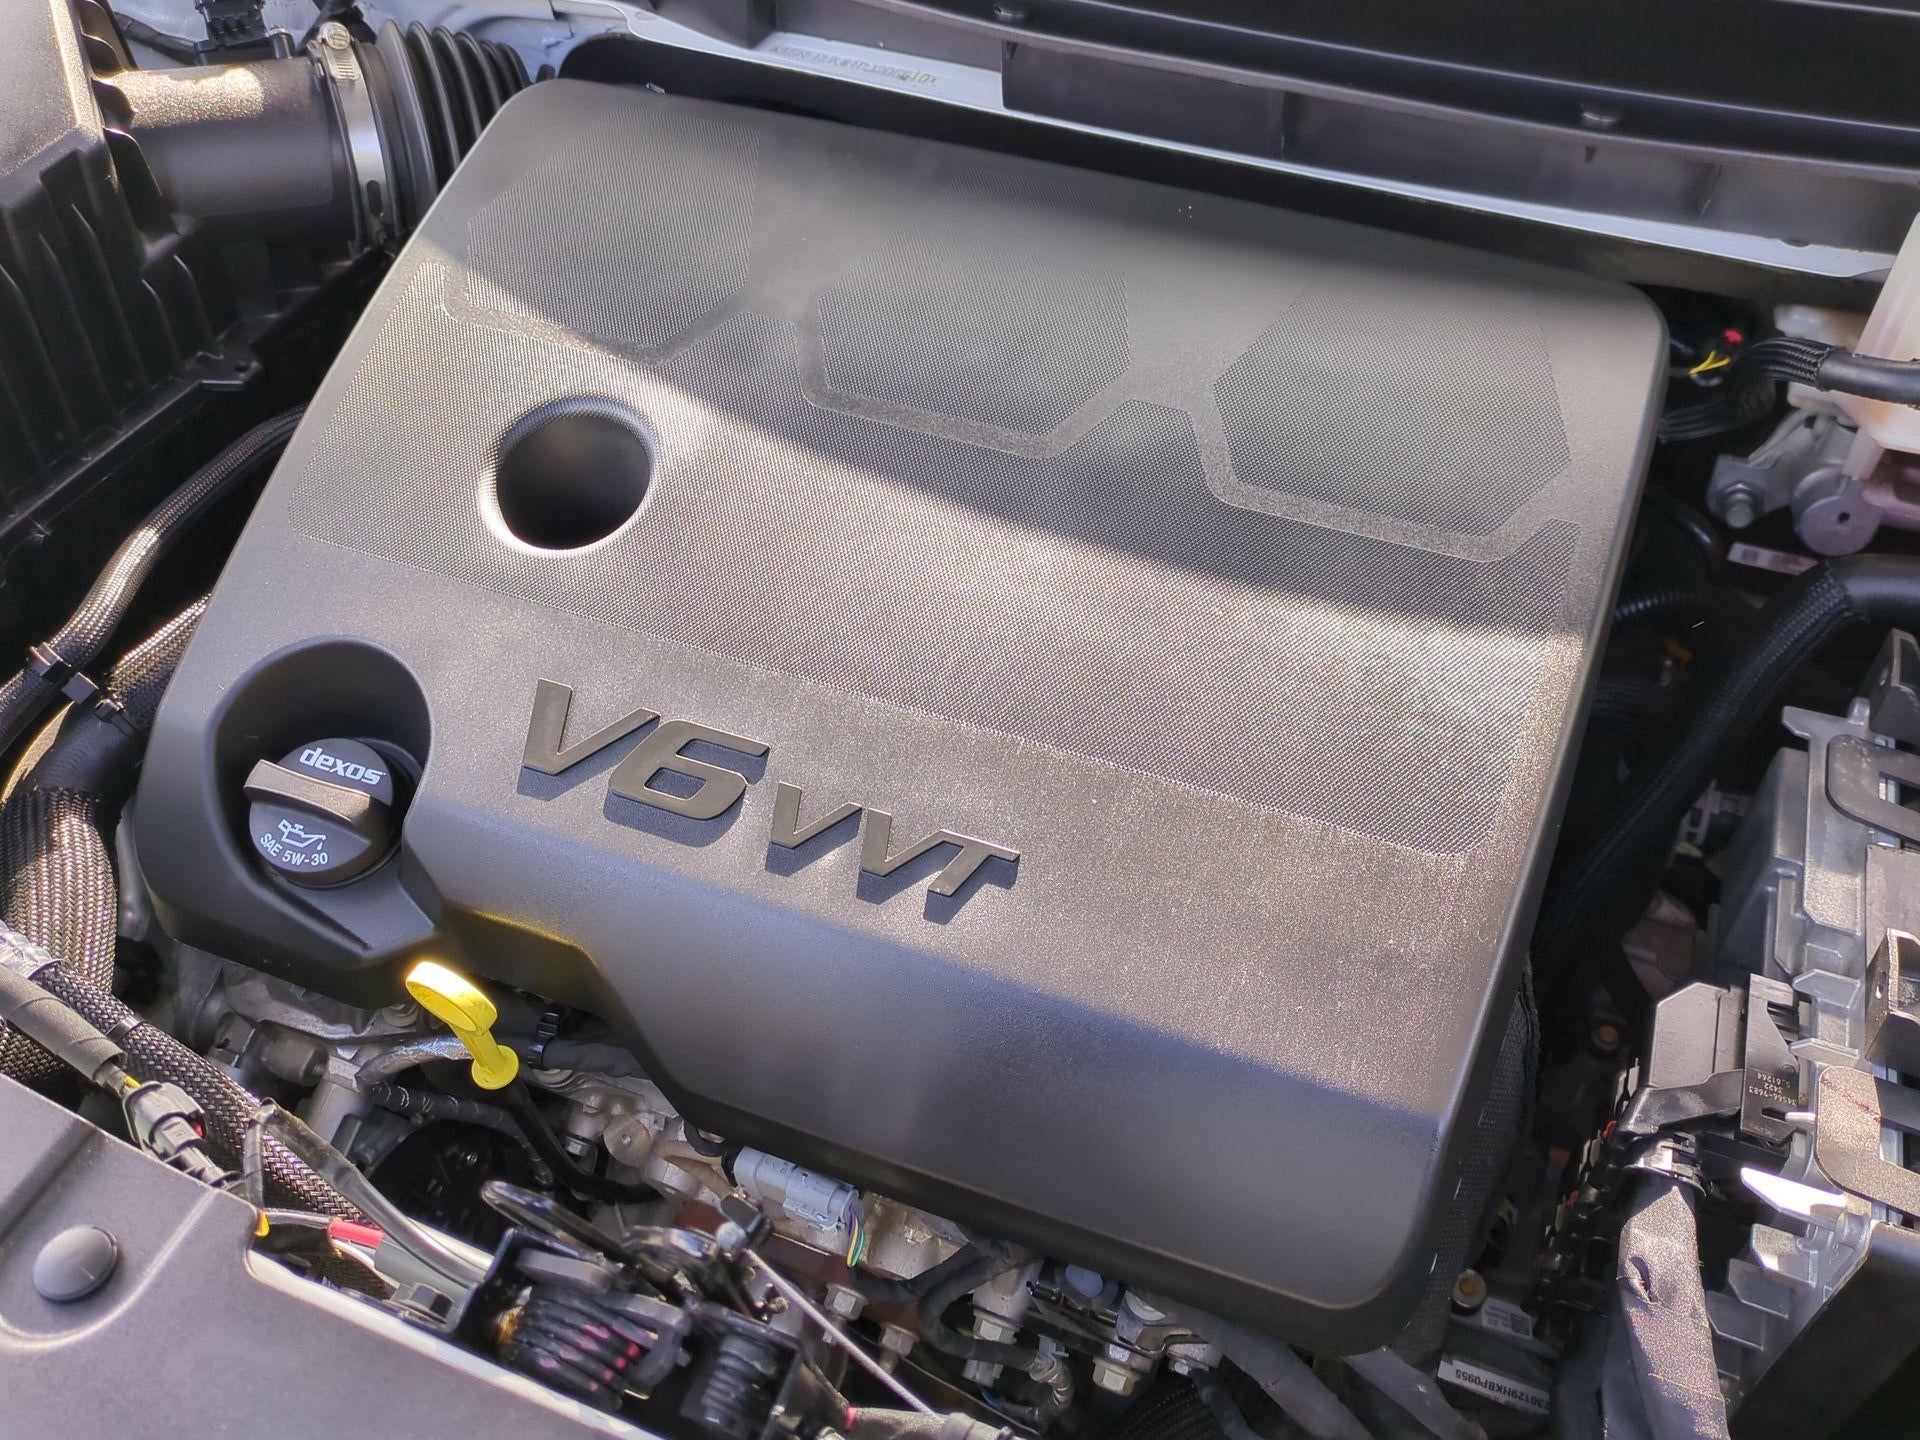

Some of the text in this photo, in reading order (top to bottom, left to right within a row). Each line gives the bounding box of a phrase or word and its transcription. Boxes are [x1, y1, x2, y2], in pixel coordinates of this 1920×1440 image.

[299, 747, 383, 785] dexos
[523, 678, 1020, 897] V6 VVT
[260, 833, 328, 866] SAE 5W-30
